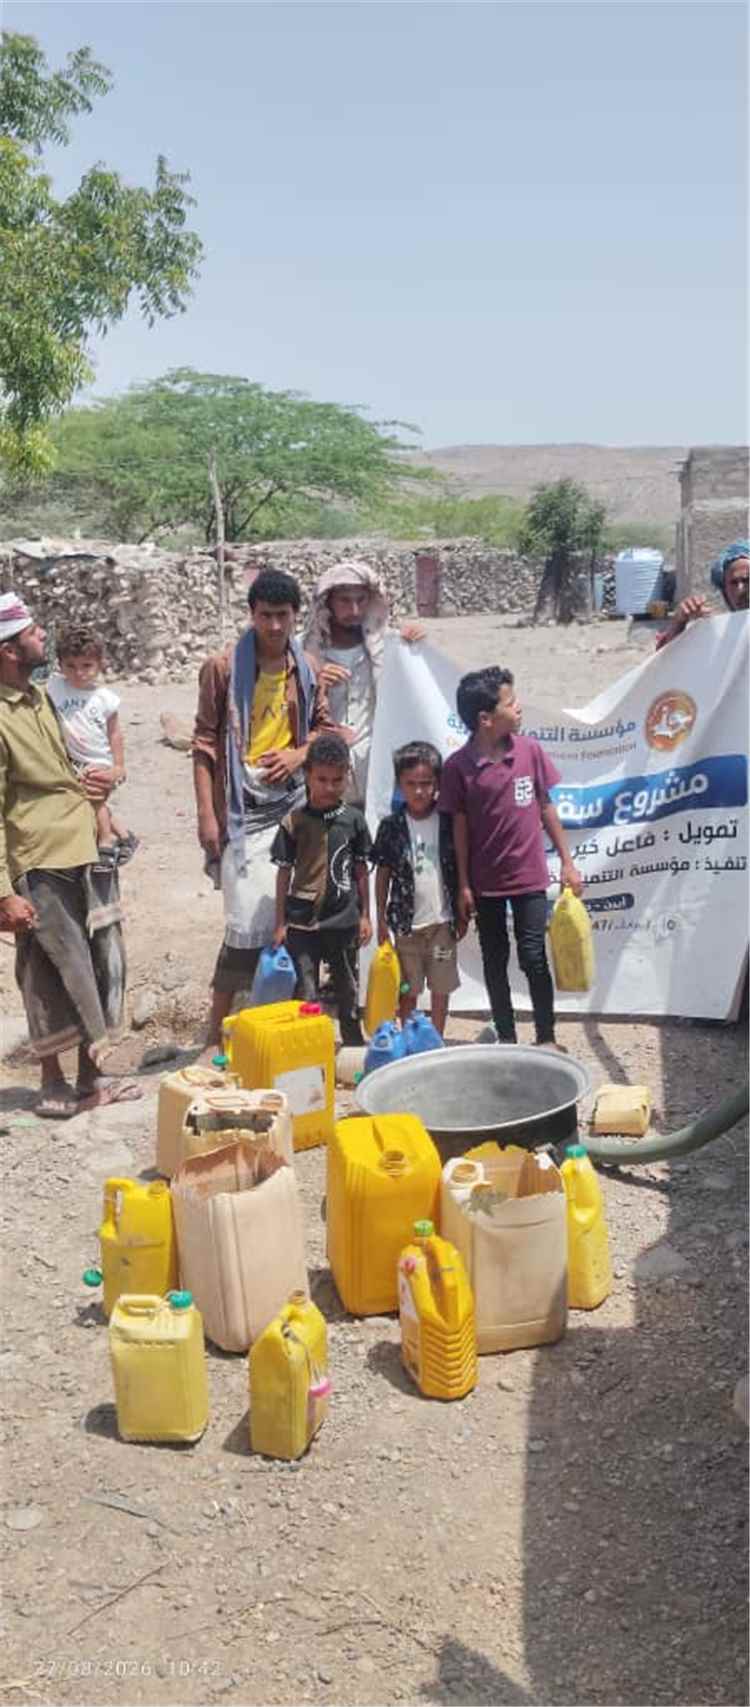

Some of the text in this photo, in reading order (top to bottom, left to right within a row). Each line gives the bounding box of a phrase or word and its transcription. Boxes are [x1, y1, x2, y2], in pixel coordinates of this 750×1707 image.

[567, 719, 637, 742] مؤسسة
[613, 770, 709, 825] مشروع
[678, 818, 739, 846] تمويل
[572, 838, 600, 860] خير
[605, 829, 656, 858] فاعل
[629, 858, 691, 876] مؤسسة
[703, 856, 748, 875] تنفيذ
[581, 868, 624, 888] التنمي
